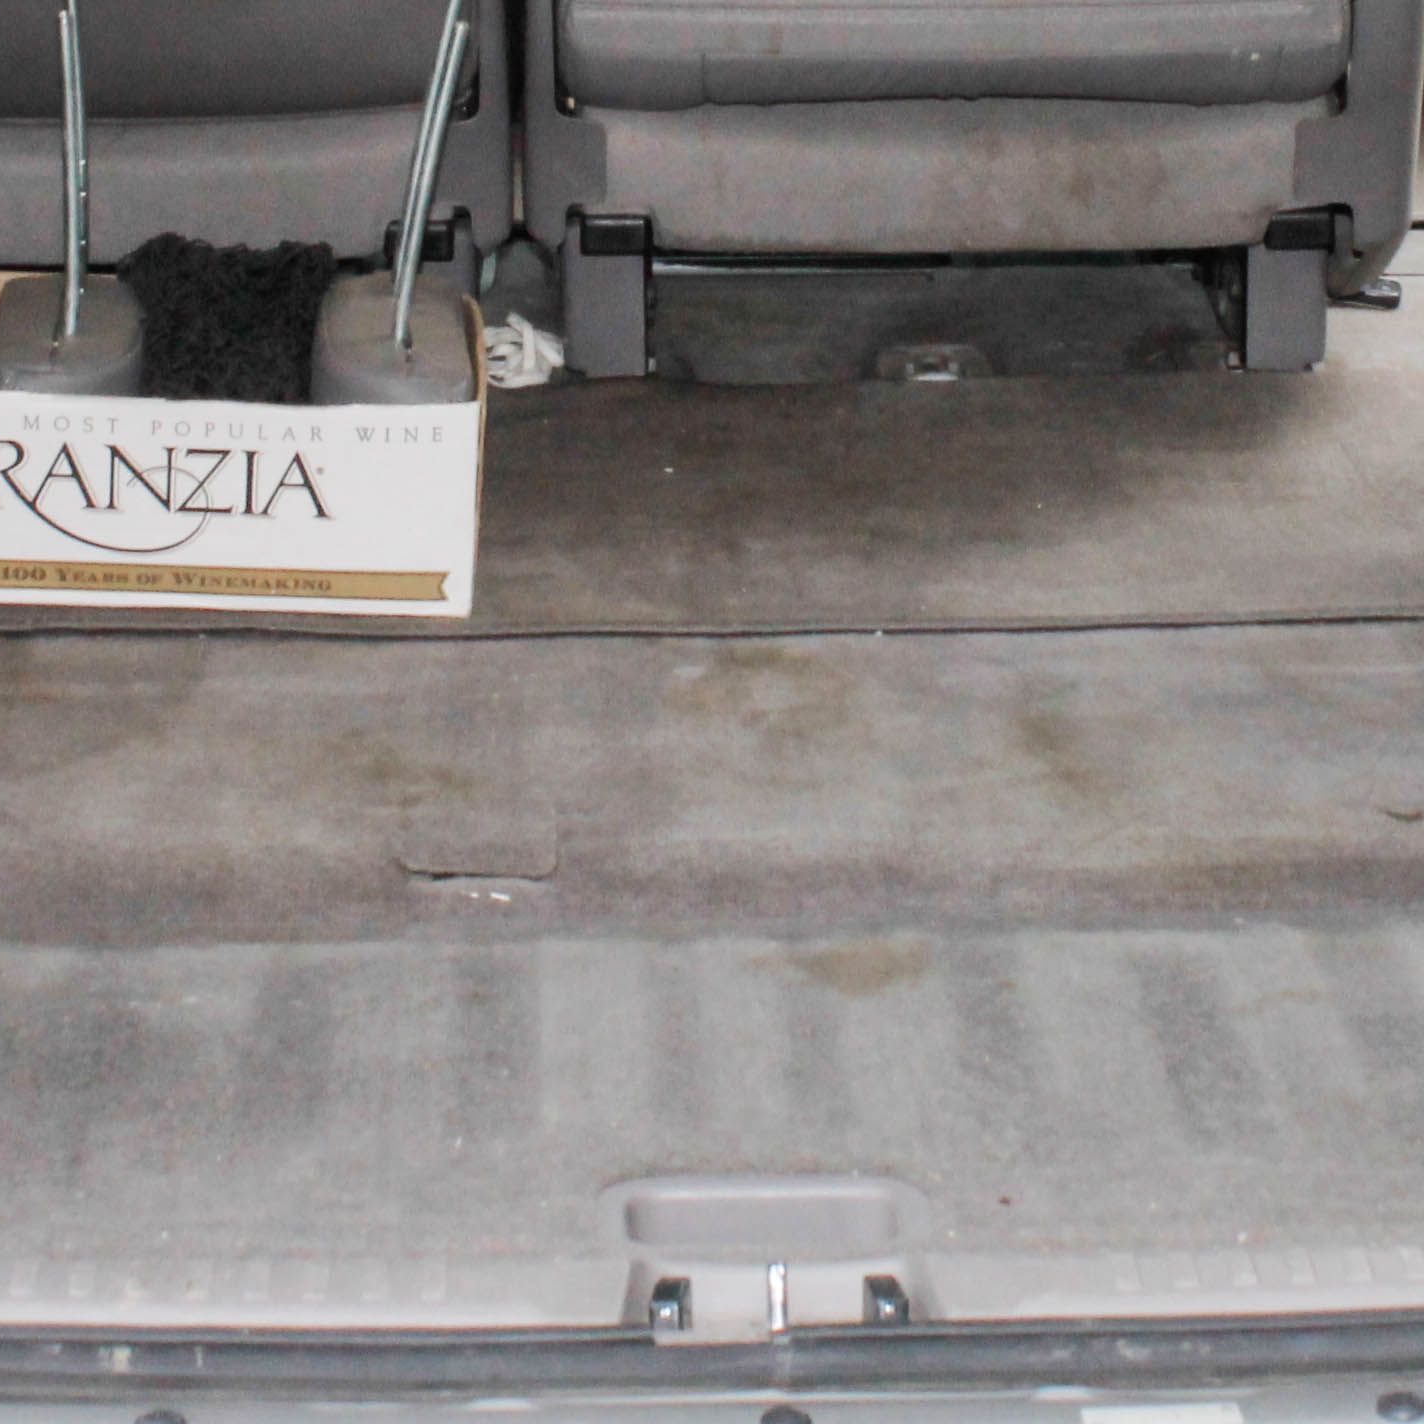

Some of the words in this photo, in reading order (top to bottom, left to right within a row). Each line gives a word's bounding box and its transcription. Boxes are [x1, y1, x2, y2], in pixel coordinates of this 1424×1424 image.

[23, 415, 120, 434] MOST
[150, 419, 324, 442] POPULAR
[355, 426, 444, 443] WINE
[2, 565, 48, 582] 100
